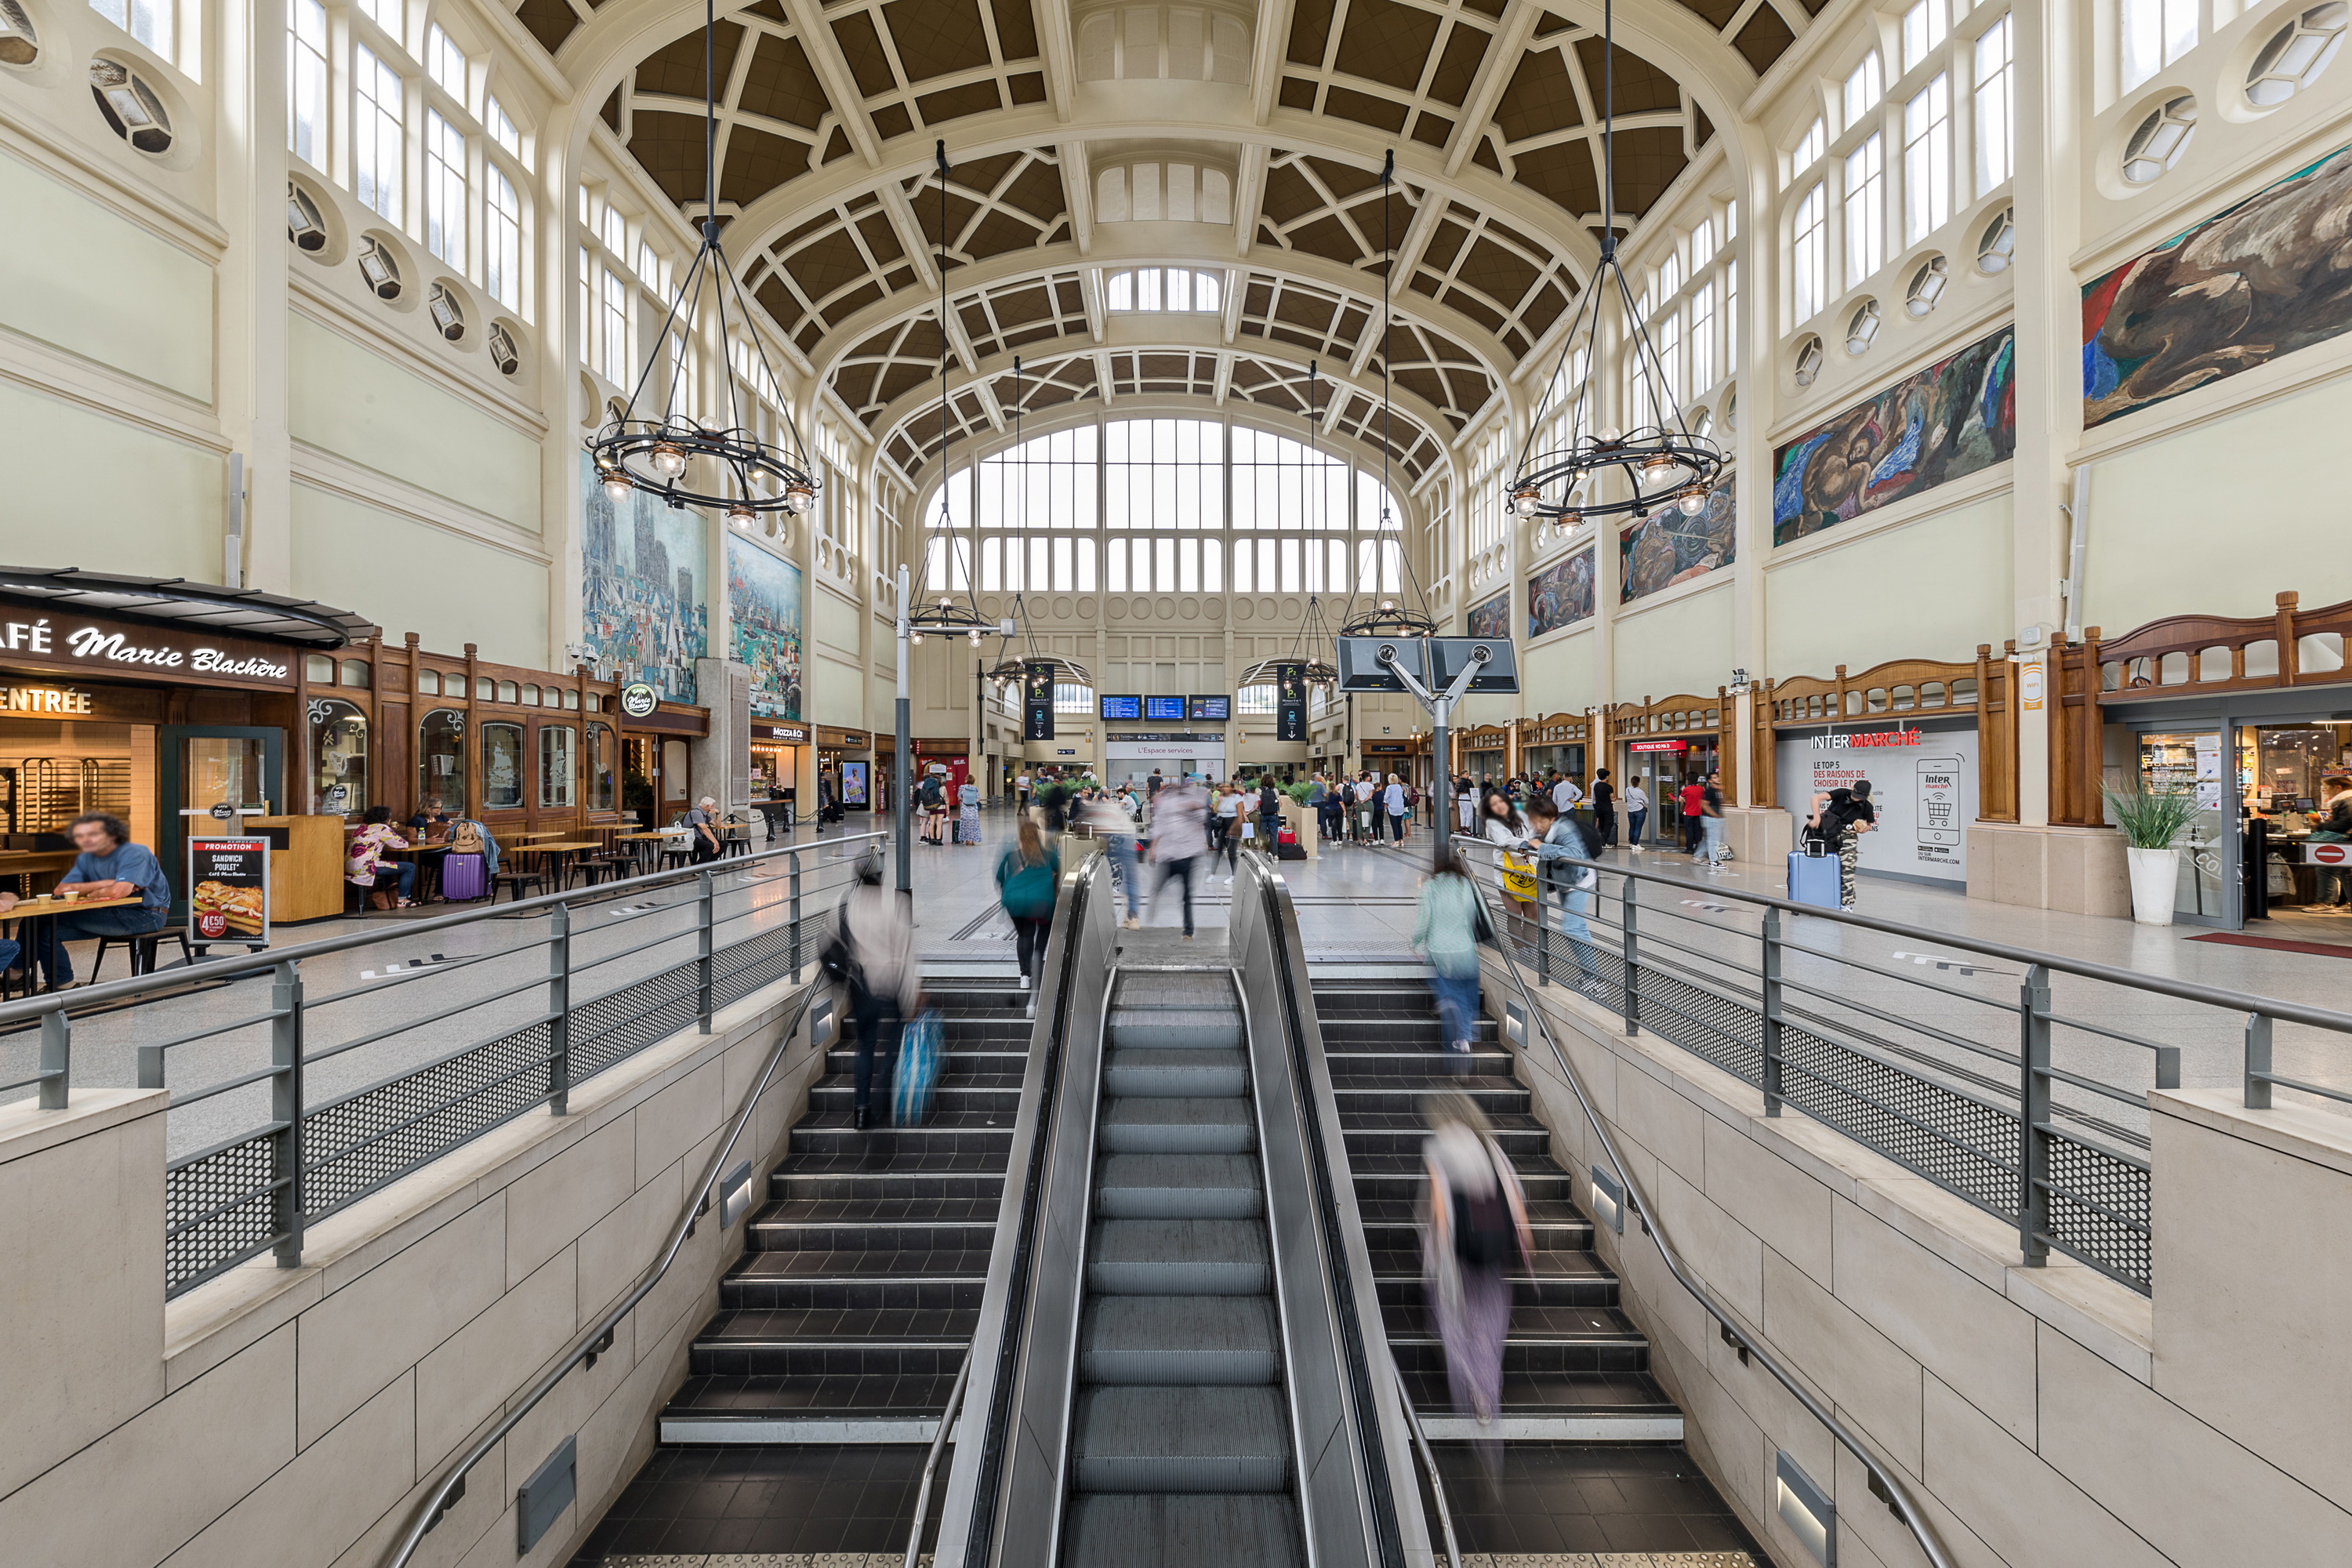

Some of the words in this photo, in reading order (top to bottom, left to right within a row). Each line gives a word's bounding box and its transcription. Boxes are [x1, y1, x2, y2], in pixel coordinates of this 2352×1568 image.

[0, 619, 52, 654] FÉ
[66, 626, 183, 666] Marie
[190, 648, 288, 679] Blachère
[627, 695, 651, 704] Marie
[1811, 727, 1921, 750] INTERMARCHÉ
[1813, 770, 1825, 779] DES
[1827, 770, 1854, 779] RAISONS
[1918, 855, 1960, 865] INTERMARCHE.COM
